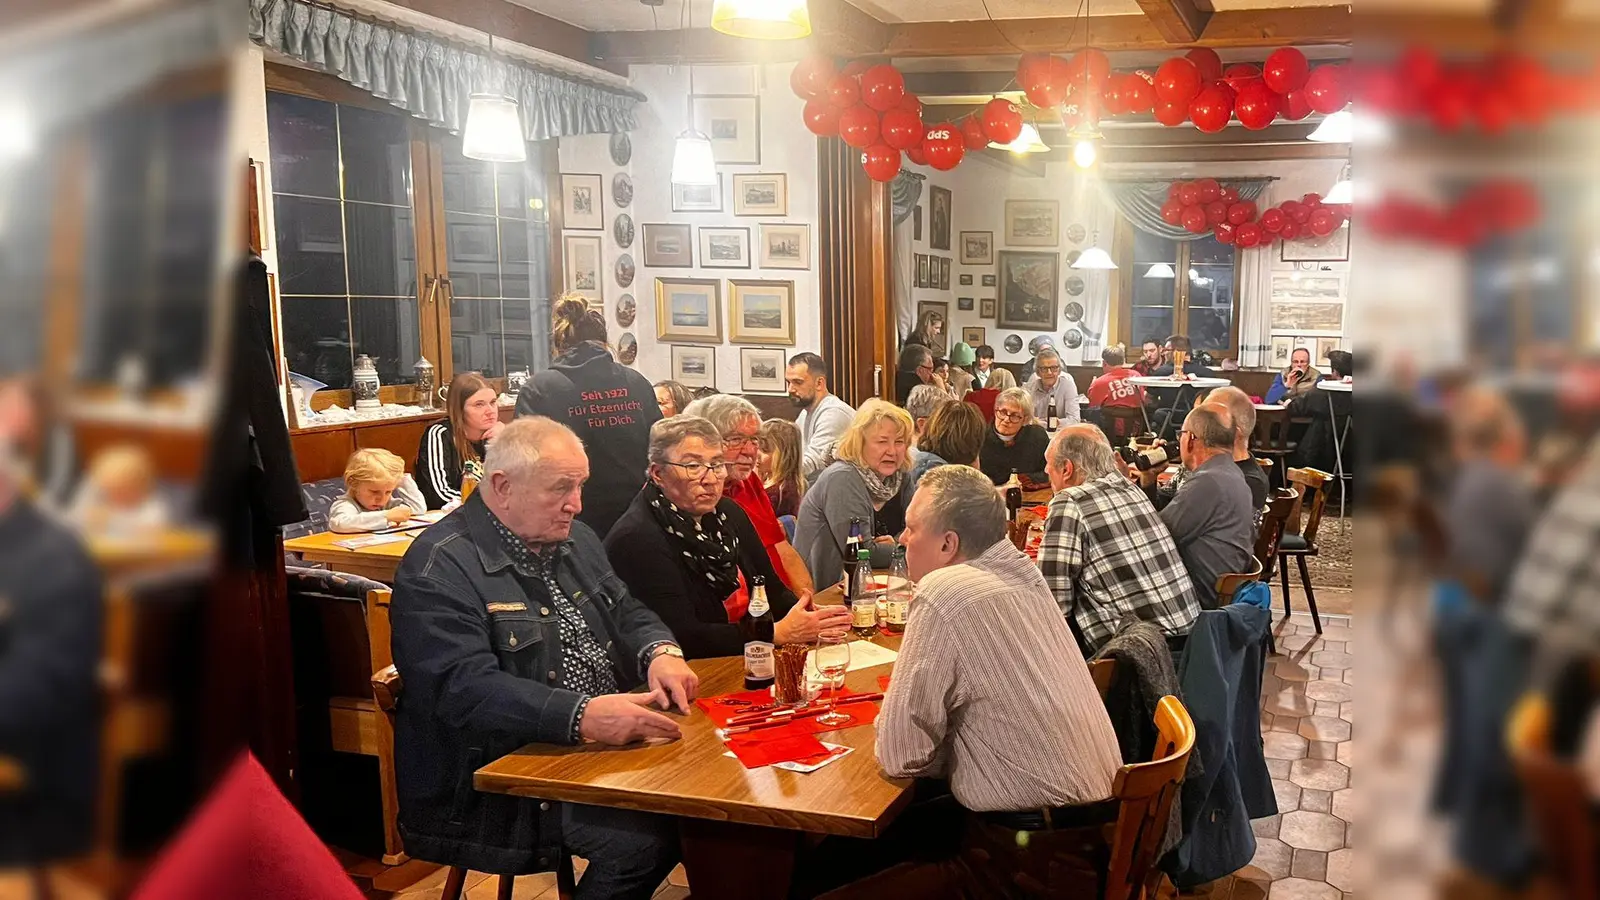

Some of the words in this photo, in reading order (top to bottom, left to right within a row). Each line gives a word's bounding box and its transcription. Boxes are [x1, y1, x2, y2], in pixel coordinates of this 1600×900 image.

[926, 130, 950, 140] SPD
[581, 390, 603, 401] Seit
[604, 388, 628, 399] 1927
[568, 406, 586, 417] Für
[588, 418, 606, 428] Für
[609, 415, 635, 426] Dich.
